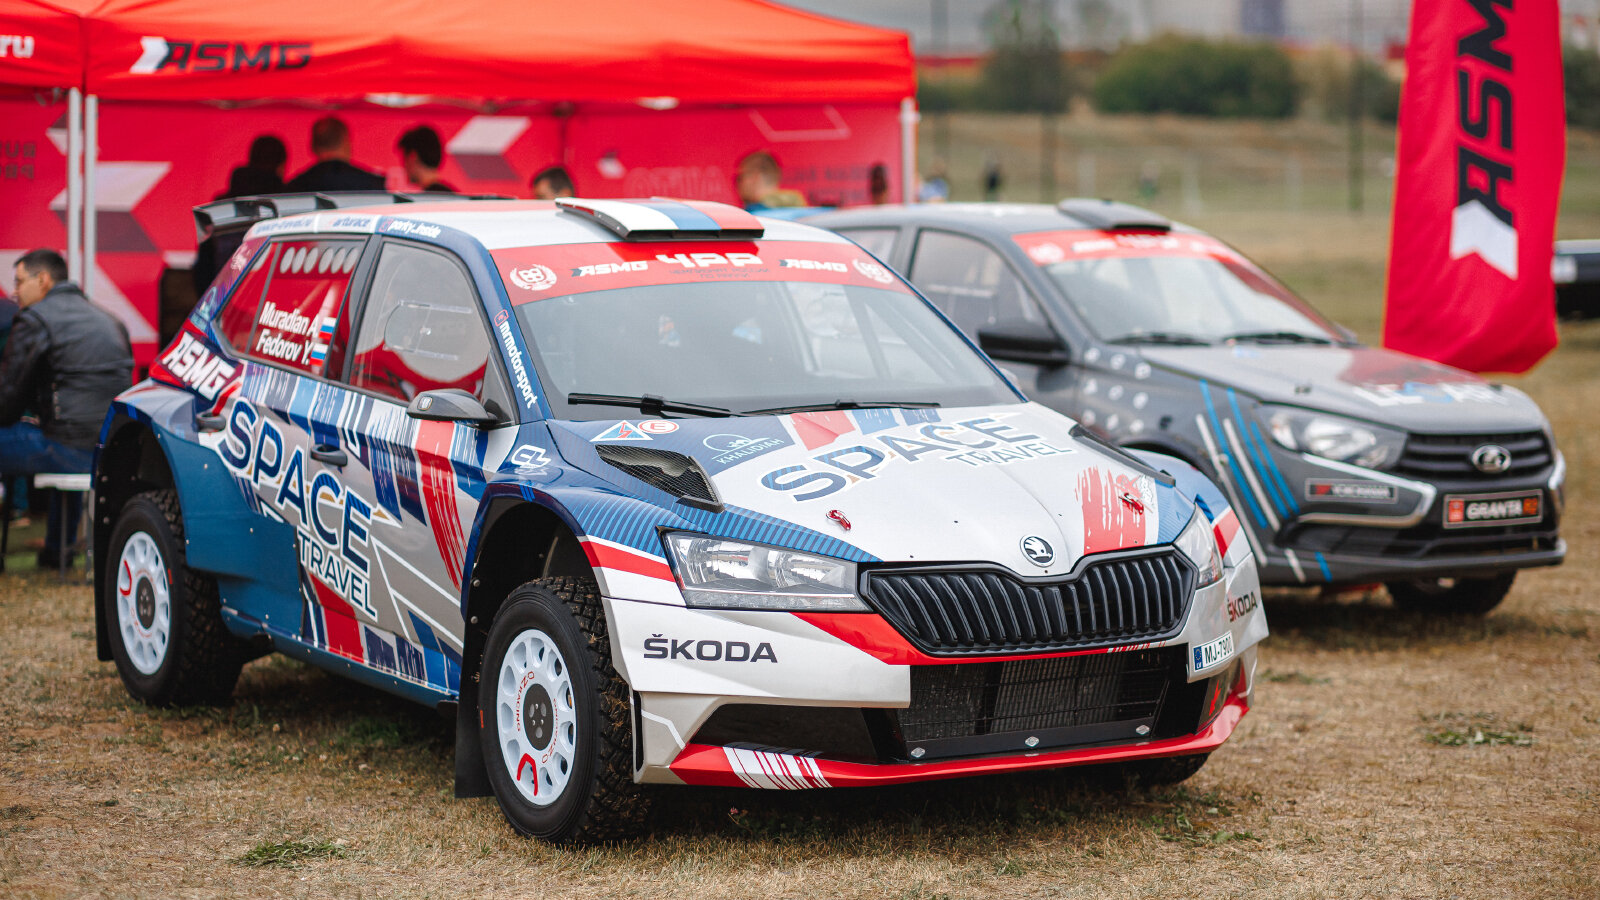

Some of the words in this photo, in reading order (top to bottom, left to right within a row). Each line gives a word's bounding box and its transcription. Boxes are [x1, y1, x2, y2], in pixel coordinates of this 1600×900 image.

[156, 41, 313, 72] ASMG
[578, 261, 648, 277] ASMG
[785, 259, 848, 273] ASMG
[259, 301, 310, 336] Muradian
[256, 328, 303, 362] Fedorov
[301, 340, 315, 366] Y.
[162, 331, 236, 401] ASMG
[499, 320, 539, 408] mrmotorsport
[716, 438, 785, 464] KHALIDIAH
[761, 416, 1041, 502] SPACE
[945, 444, 1072, 466] TRAVEL
[217, 398, 373, 579] SPACE
[1466, 501, 1523, 520] GRANTA
[298, 532, 377, 622] TRAVEL
[1227, 591, 1258, 622] ŠKODA
[643, 633, 778, 663] ŠKODA
